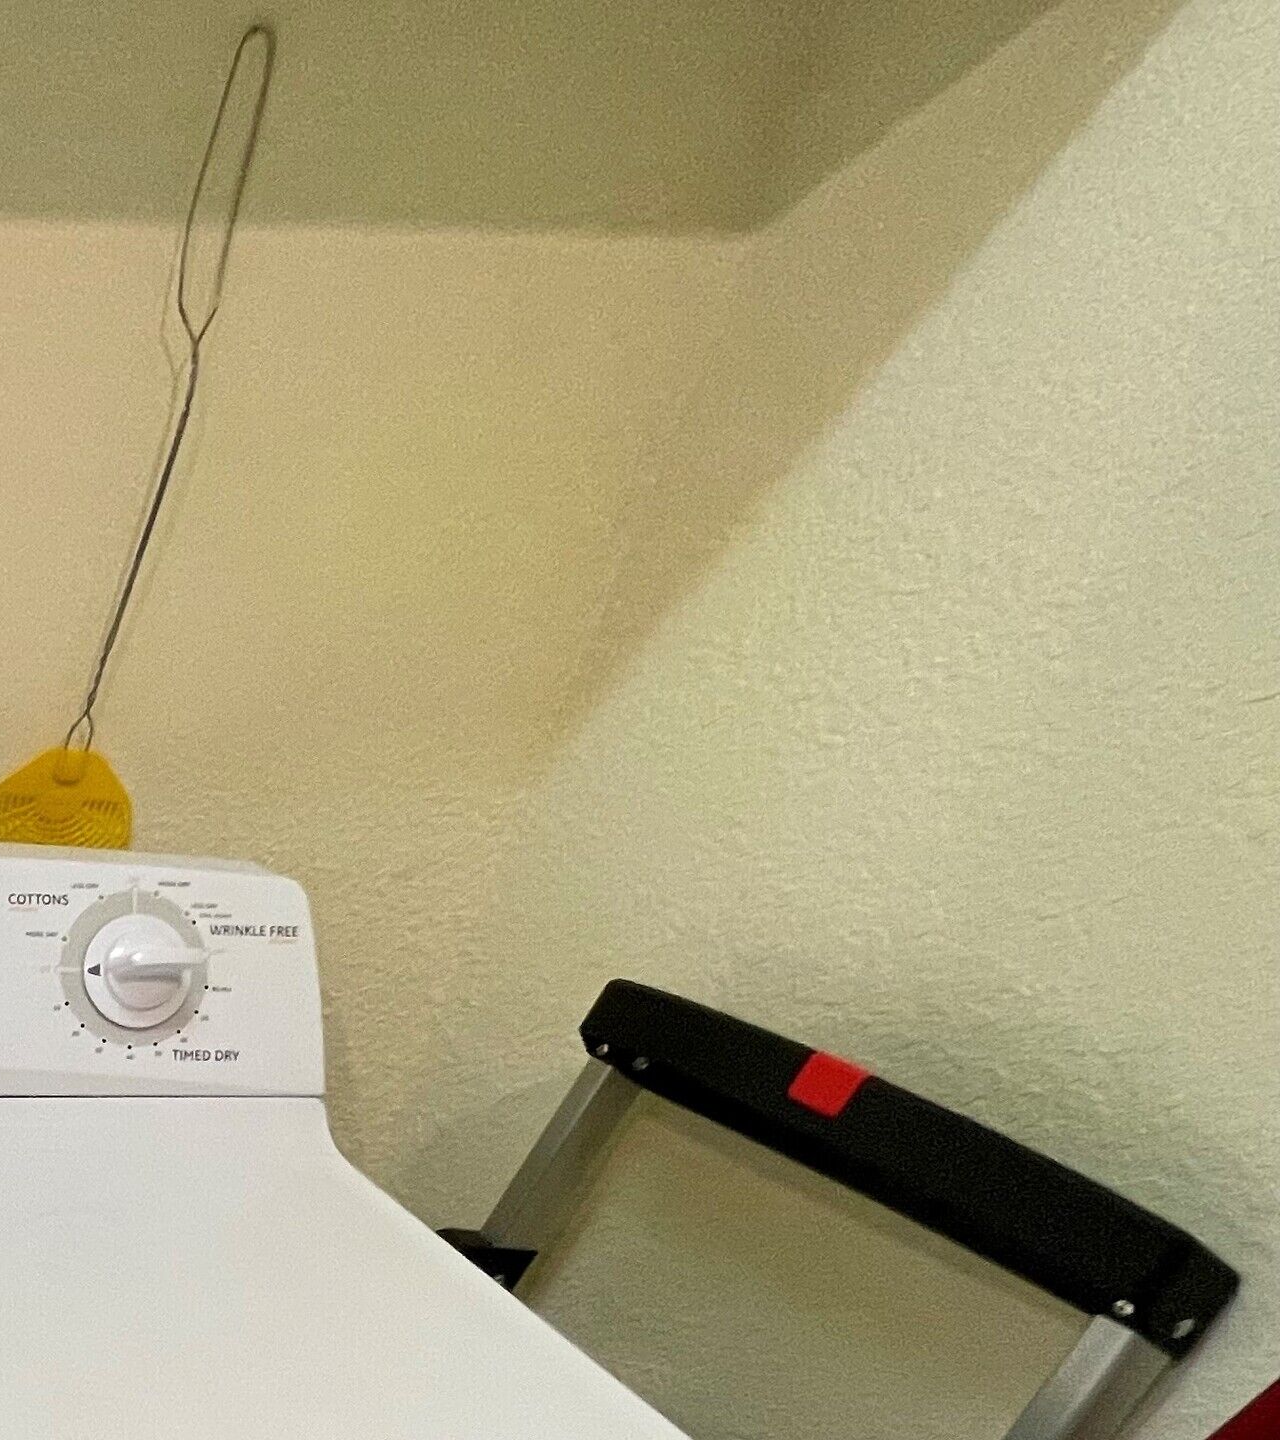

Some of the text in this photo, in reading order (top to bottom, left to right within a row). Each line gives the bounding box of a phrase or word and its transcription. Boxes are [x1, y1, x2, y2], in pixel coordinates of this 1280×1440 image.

[7, 893, 70, 906] COTTONS
[209, 924, 299, 939] WRINKLE FREE
[172, 1049, 212, 1062] TIMED
[214, 1049, 240, 1062] DRY
